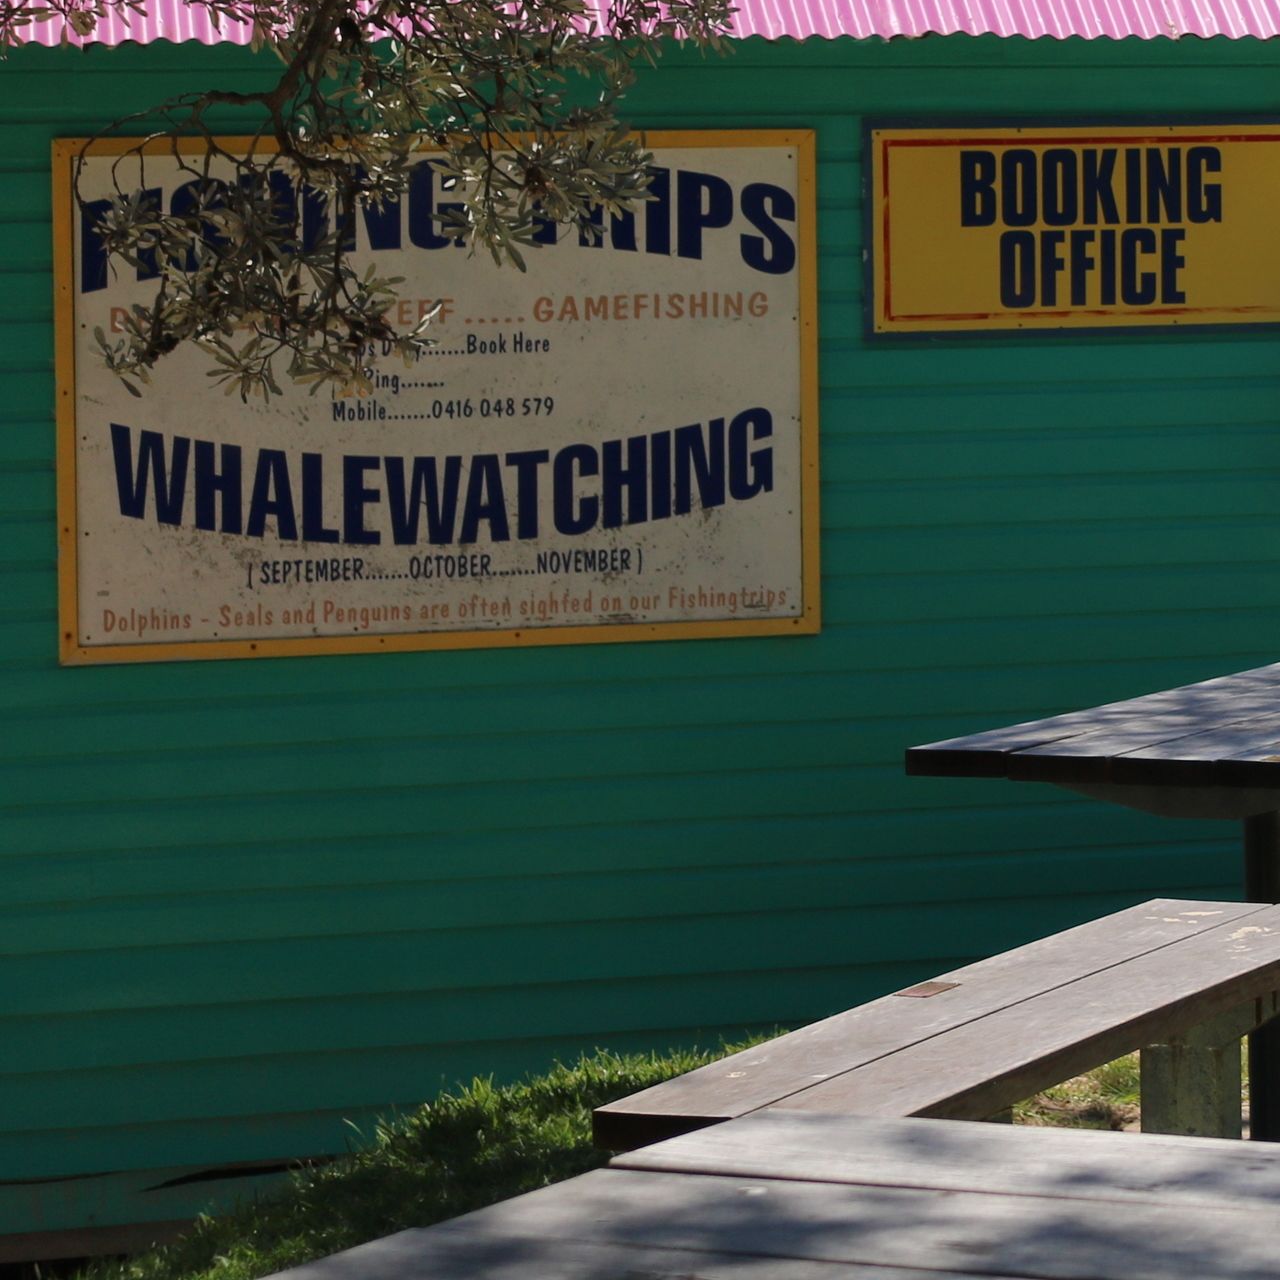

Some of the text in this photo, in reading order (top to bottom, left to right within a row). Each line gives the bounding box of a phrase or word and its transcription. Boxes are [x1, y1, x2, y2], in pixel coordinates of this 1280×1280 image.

[960, 146, 1222, 227] BOOKING
[1000, 228, 1186, 308] OFFICE
[533, 291, 768, 322] GAMEFISHING
[513, 331, 550, 353] Here
[480, 397, 515, 418] 048
[522, 396, 554, 417] 579
[110, 407, 773, 546] WHALEWATCHING
[103, 608, 192, 637] Dolphins
[219, 603, 273, 629] Seals
[282, 601, 316, 625] and
[323, 599, 411, 629] Penguins
[419, 601, 449, 619] are
[458, 593, 511, 617] often
[600, 595, 624, 611] on
[630, 594, 660, 610] our
